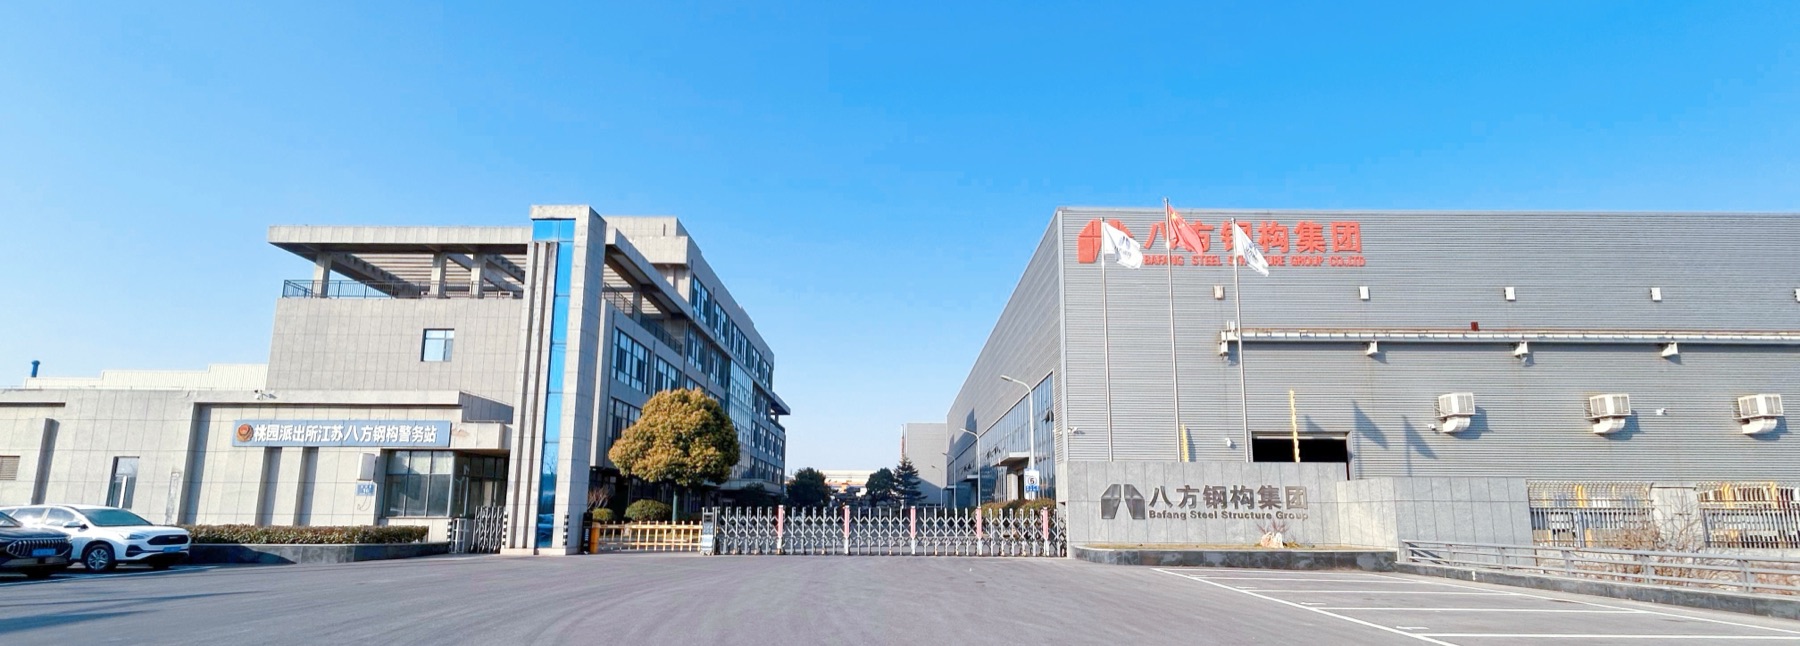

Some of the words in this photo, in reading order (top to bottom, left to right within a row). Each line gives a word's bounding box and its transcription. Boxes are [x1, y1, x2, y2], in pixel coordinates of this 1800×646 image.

[1143, 254, 1185, 266] BAFANG
[1191, 255, 1222, 266] STEEL
[1290, 255, 1324, 266] GROUP
[253, 424, 438, 443] 桃园派出所江苏八方钢构警务站
[1149, 485, 1309, 510] 八方钢构集团
[1149, 510, 1187, 521] Bafang
[1190, 510, 1218, 520] Steel
[1221, 510, 1272, 520] Structure
[1276, 510, 1309, 521] Group
